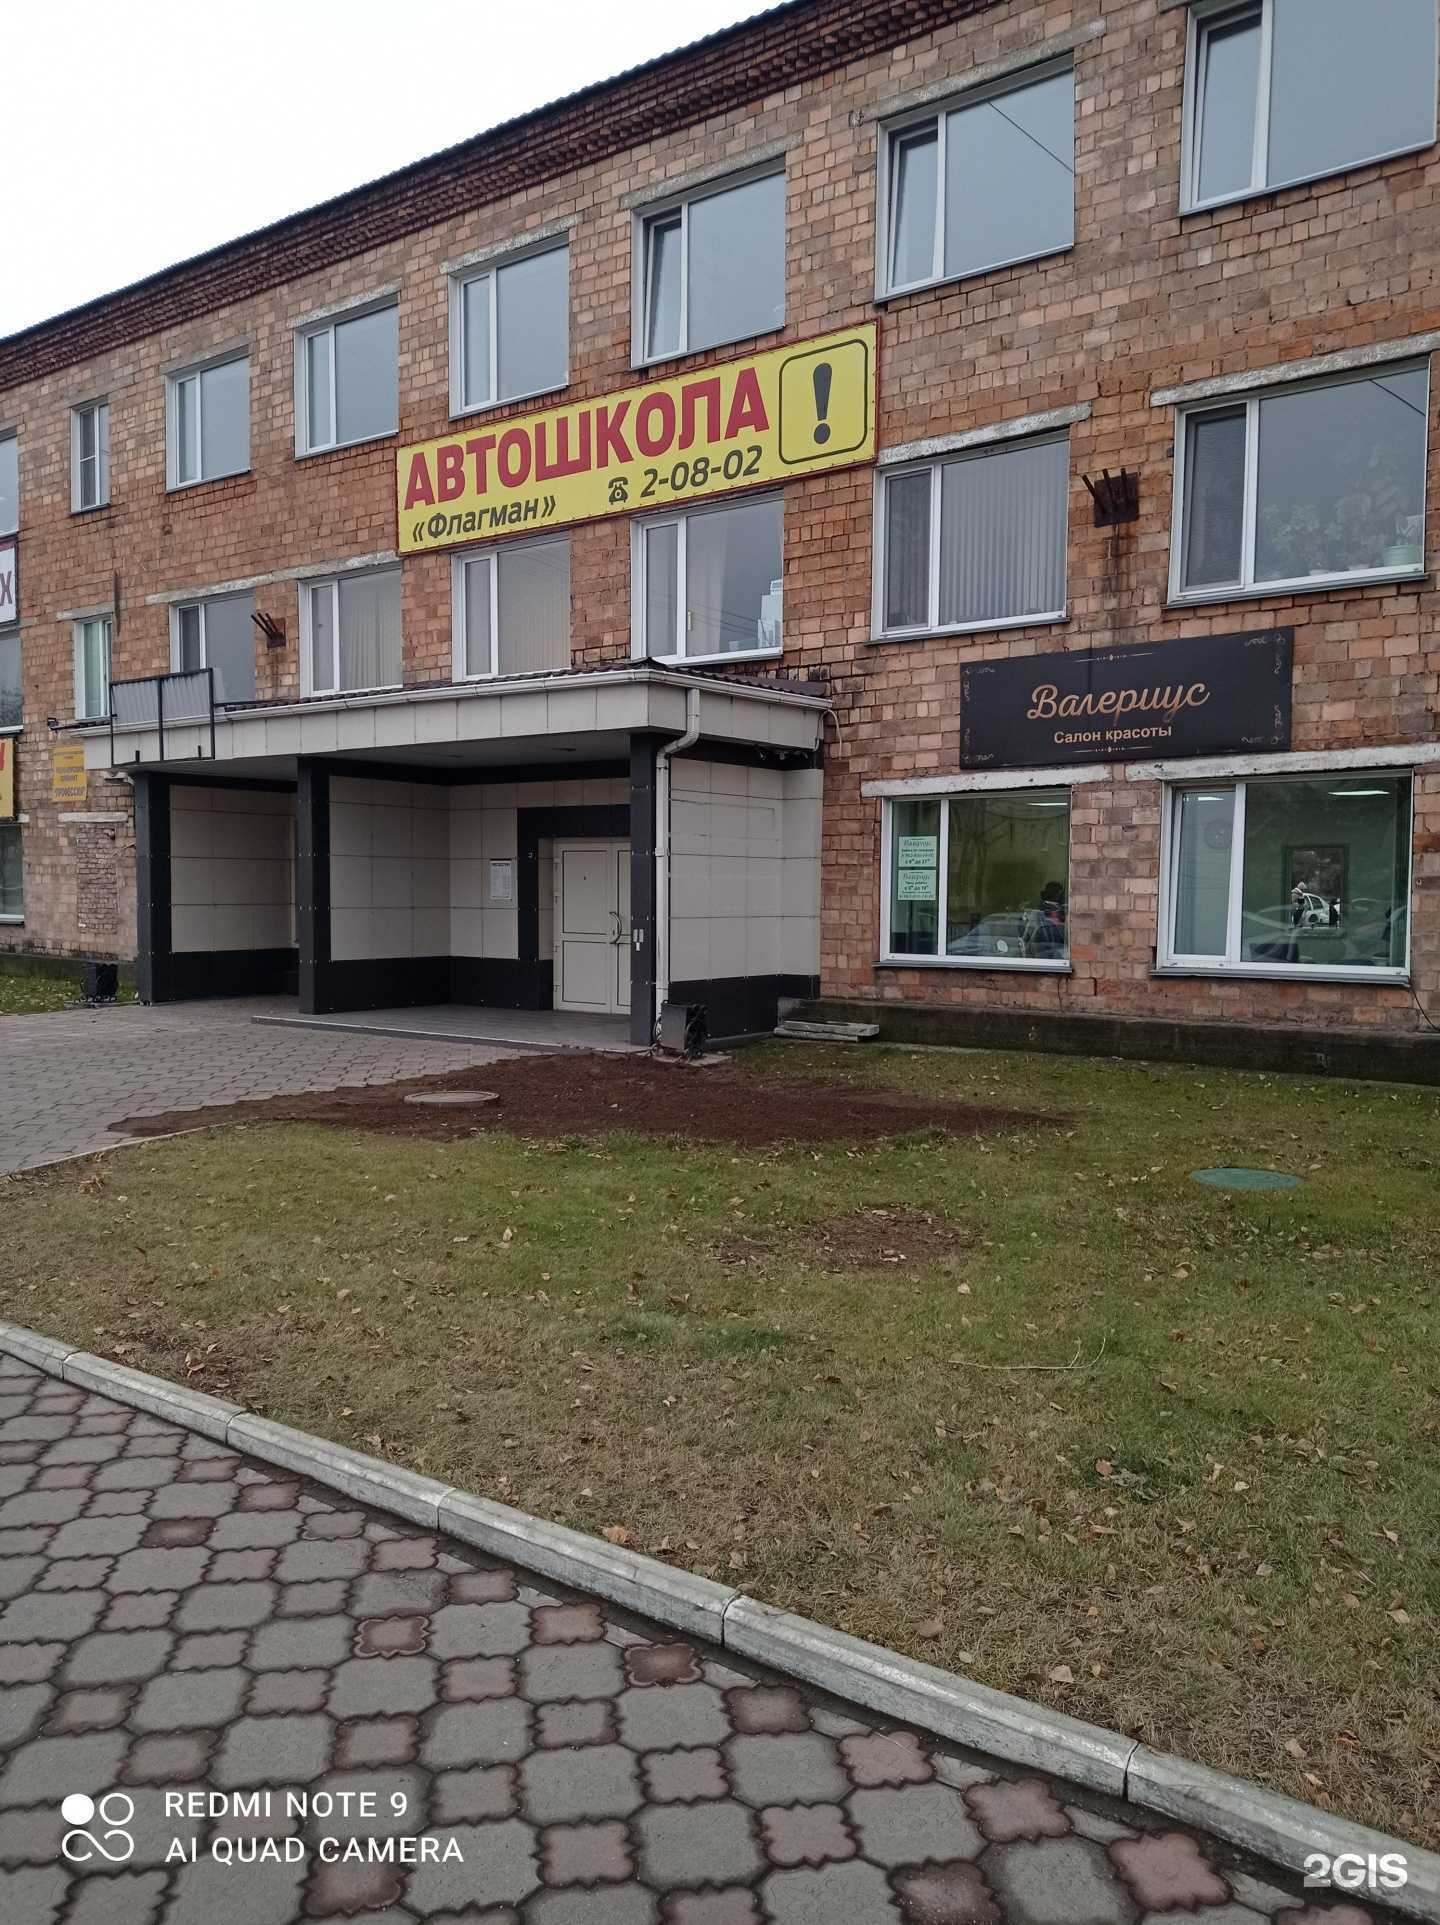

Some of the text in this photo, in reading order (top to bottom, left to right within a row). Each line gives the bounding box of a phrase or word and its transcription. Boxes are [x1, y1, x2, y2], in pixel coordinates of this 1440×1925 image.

[404, 367, 769, 510] АВТОШКОЛА
[641, 445, 763, 498] 2-08-02
[412, 494, 556, 543] «Флагман»
[1026, 682, 1210, 727] Валериус
[1054, 725, 1172, 744] Салон красоты
